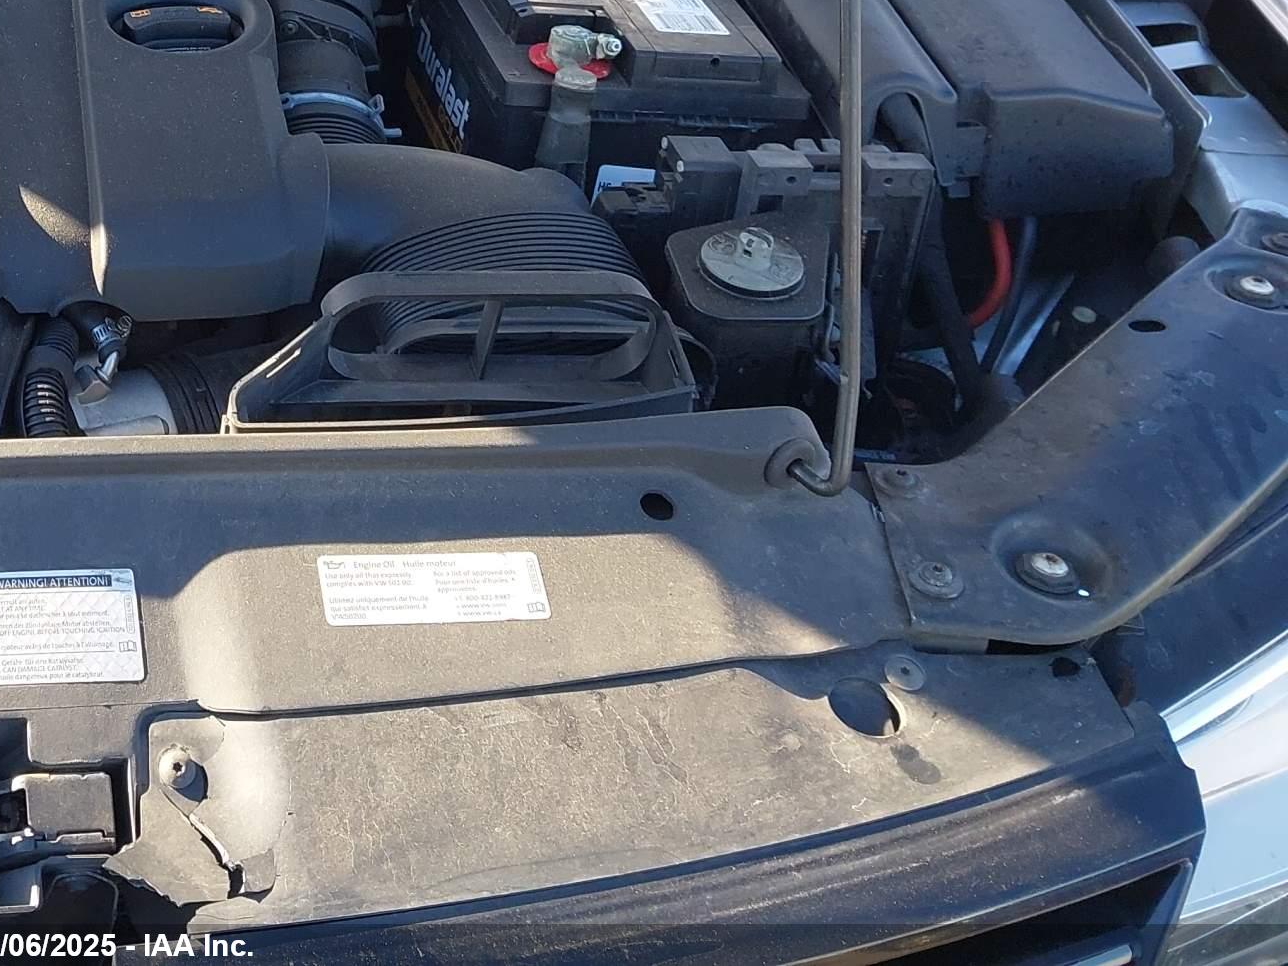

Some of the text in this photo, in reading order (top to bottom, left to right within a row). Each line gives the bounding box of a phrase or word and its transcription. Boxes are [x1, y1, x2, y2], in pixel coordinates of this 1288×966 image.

[417, 17, 470, 141] Duralast
[353, 561, 381, 570] Engine
[50, 576, 108, 587] ATTENTION!
